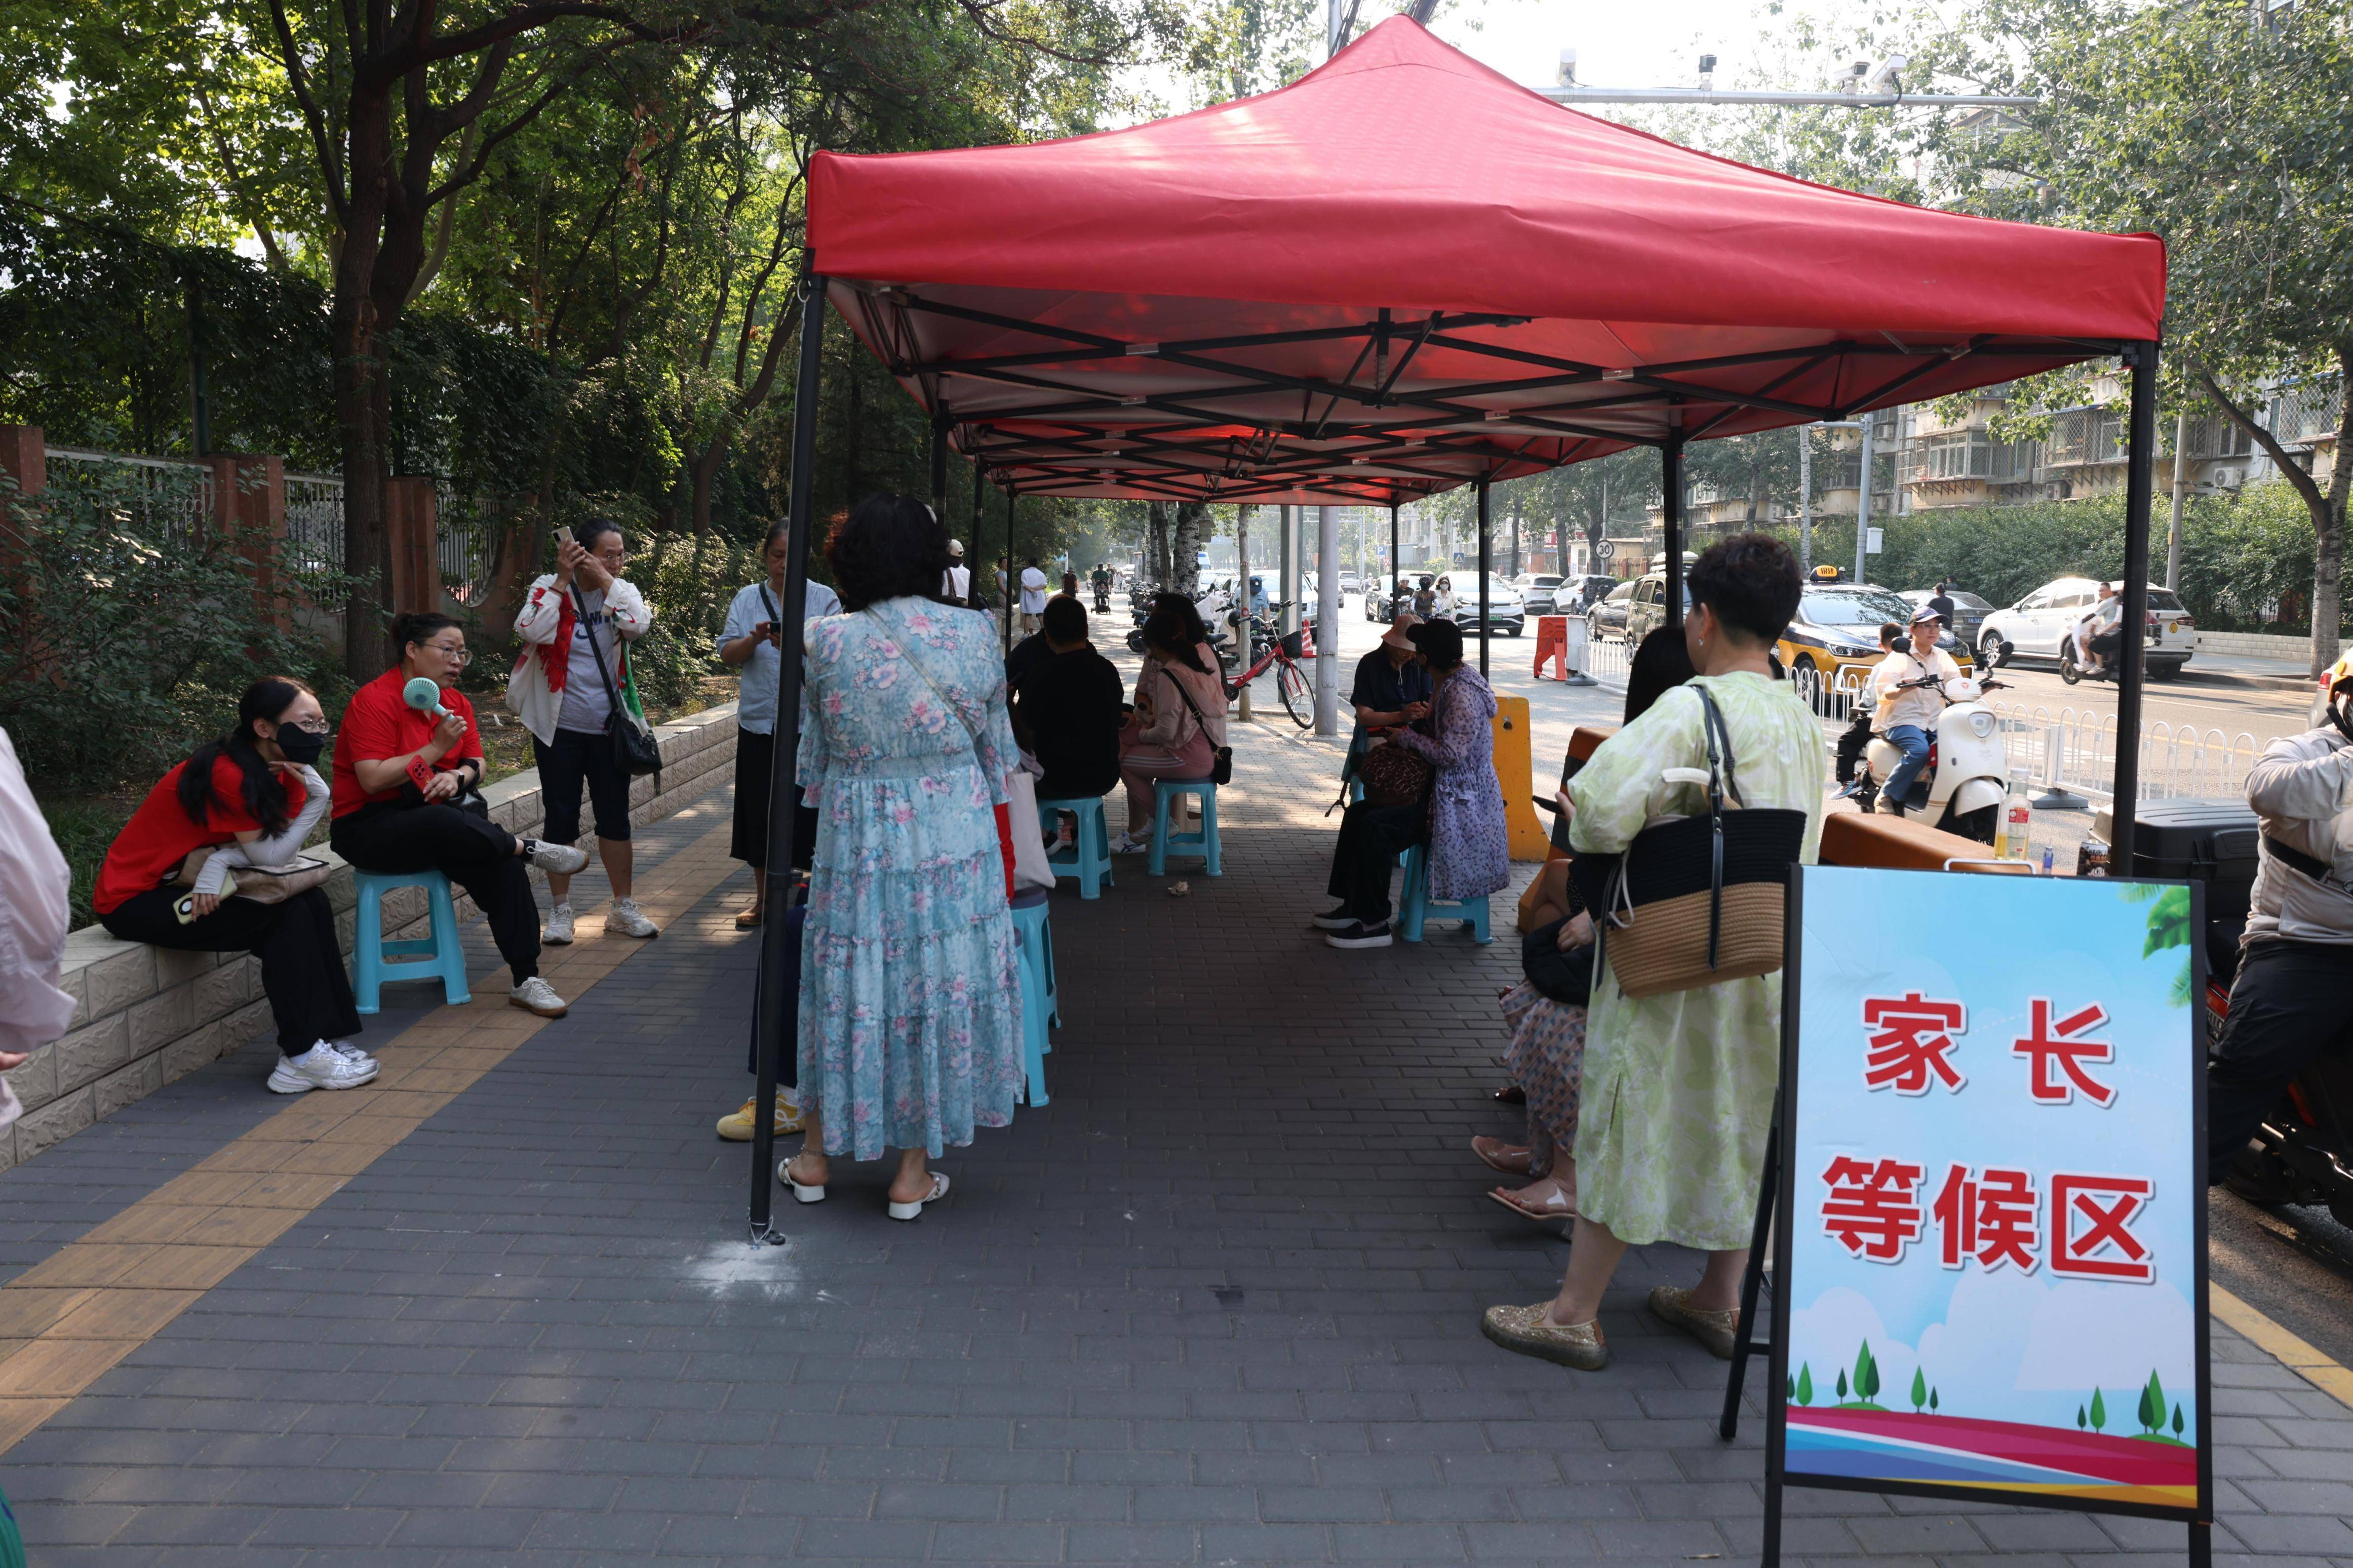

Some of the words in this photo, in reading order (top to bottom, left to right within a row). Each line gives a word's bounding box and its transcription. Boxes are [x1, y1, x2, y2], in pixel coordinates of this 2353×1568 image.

[1377, 546, 1384, 554] P
[1599, 545, 1610, 554] 30
[1863, 991, 2113, 1105] 家长
[1820, 1154, 2151, 1279] 等候区
